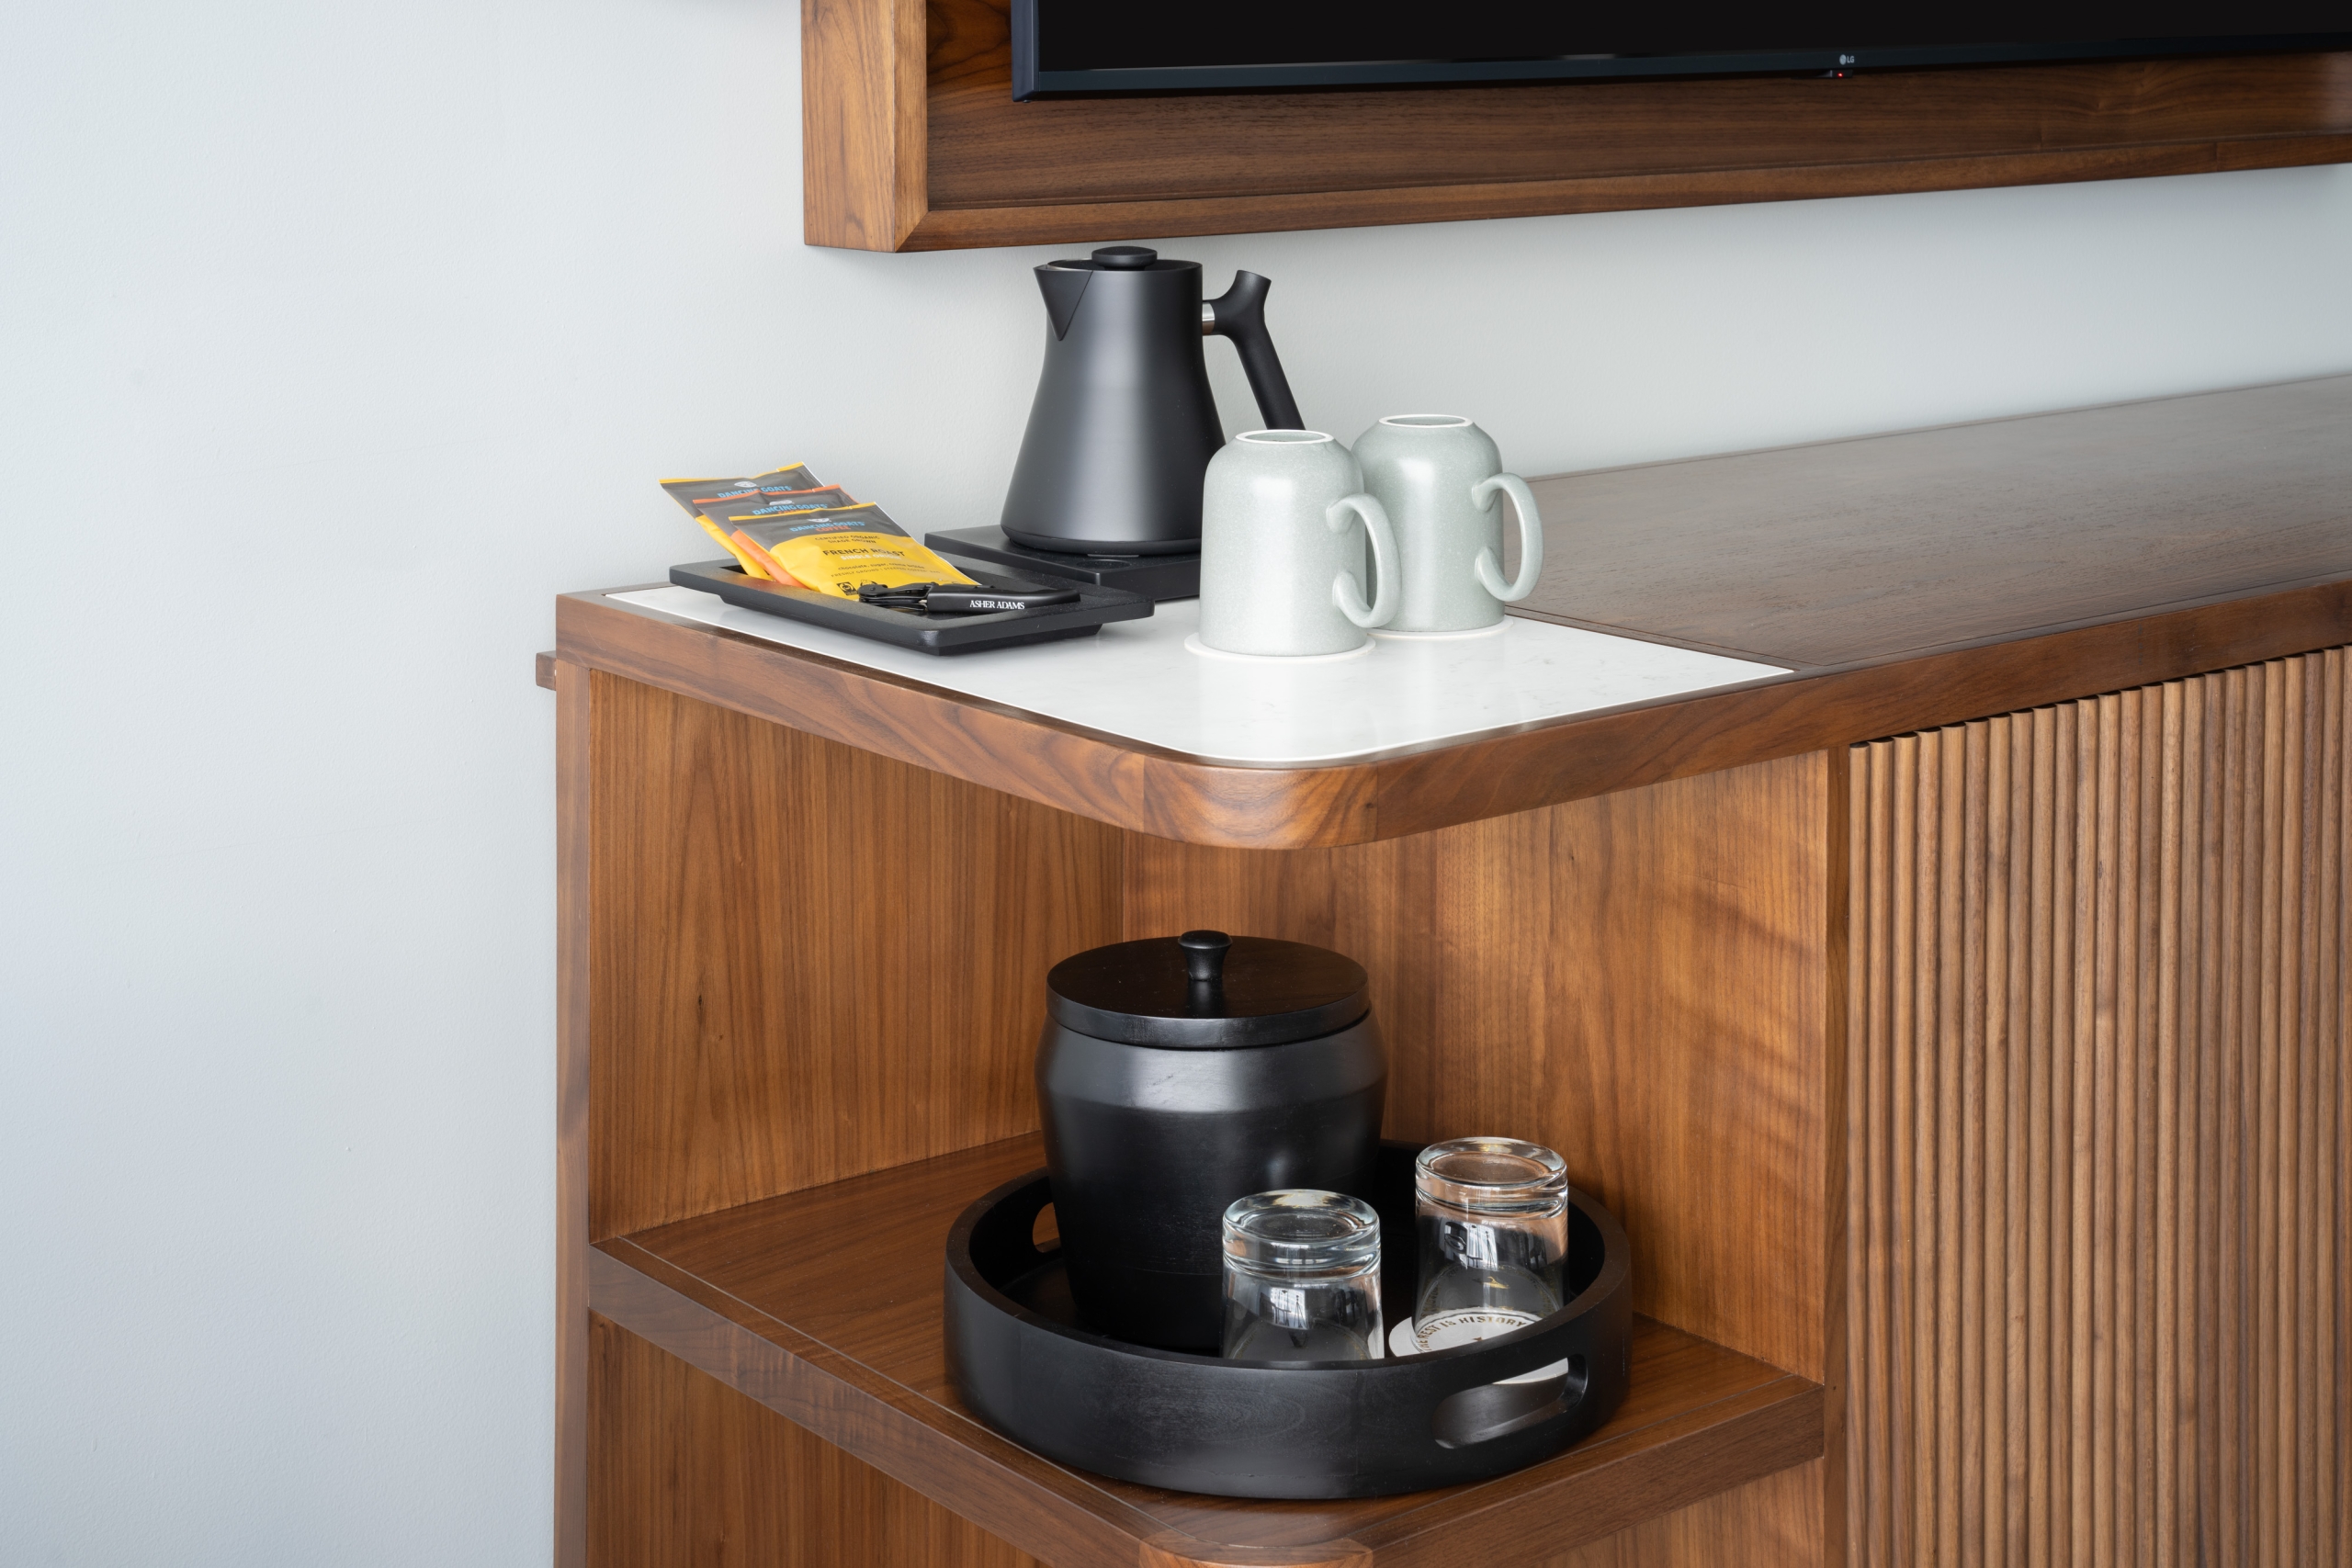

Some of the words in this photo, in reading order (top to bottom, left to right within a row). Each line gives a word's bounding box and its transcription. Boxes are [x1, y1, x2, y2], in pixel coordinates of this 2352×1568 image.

[1847, 55, 1855, 63] LG
[717, 488, 759, 498] DANCIN
[752, 504, 797, 515] DANCING
[789, 522, 834, 532] DANCING
[870, 547, 905, 557] ROAST
[970, 600, 995, 608] ASHER
[996, 601, 1025, 610] ADAMS
[1417, 1325, 1441, 1338] REST
[1458, 1315, 1526, 1327] HISTORY
